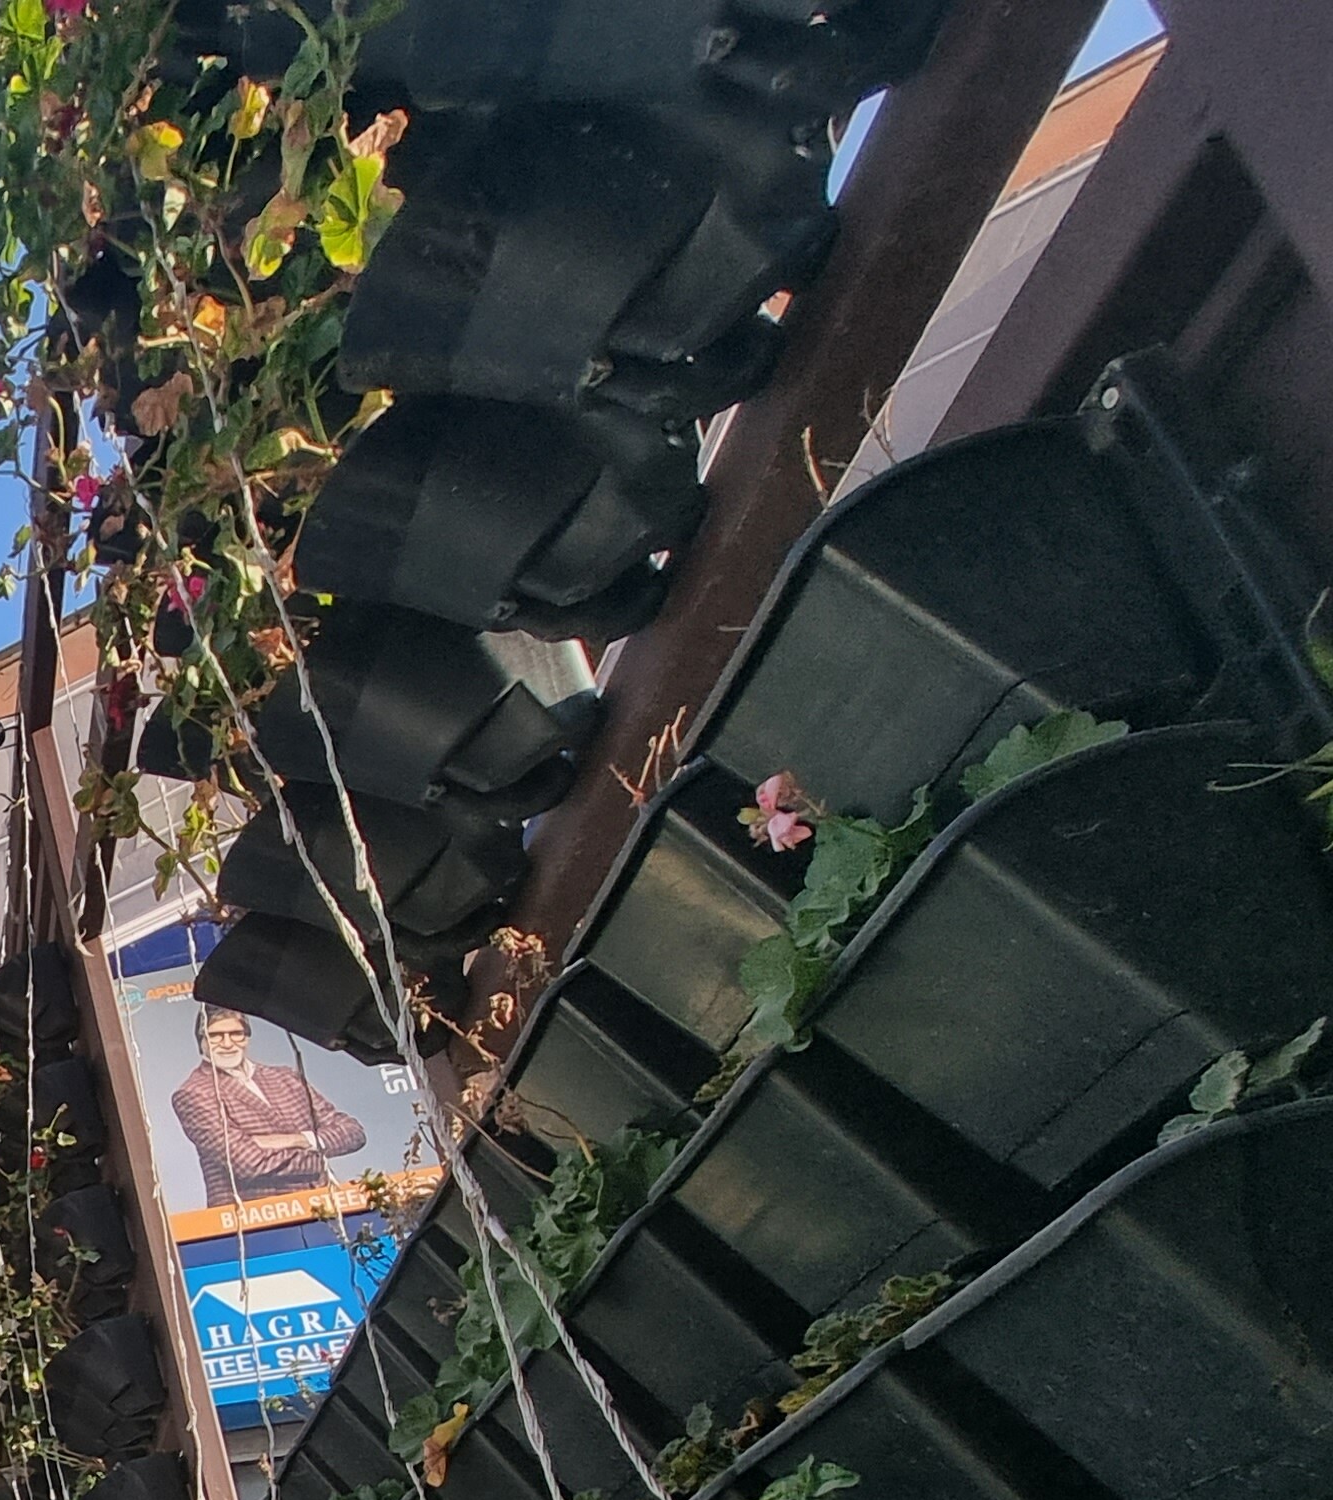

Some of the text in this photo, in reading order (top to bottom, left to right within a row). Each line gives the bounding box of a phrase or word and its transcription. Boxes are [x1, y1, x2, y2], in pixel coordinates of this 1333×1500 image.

[146, 982, 194, 1000] APOLL
[378, 1063, 409, 1095] ST
[220, 1200, 305, 1230] BHAGRA
[207, 1306, 356, 1349] HAGRA
[204, 1338, 350, 1377] TEEL SALE
